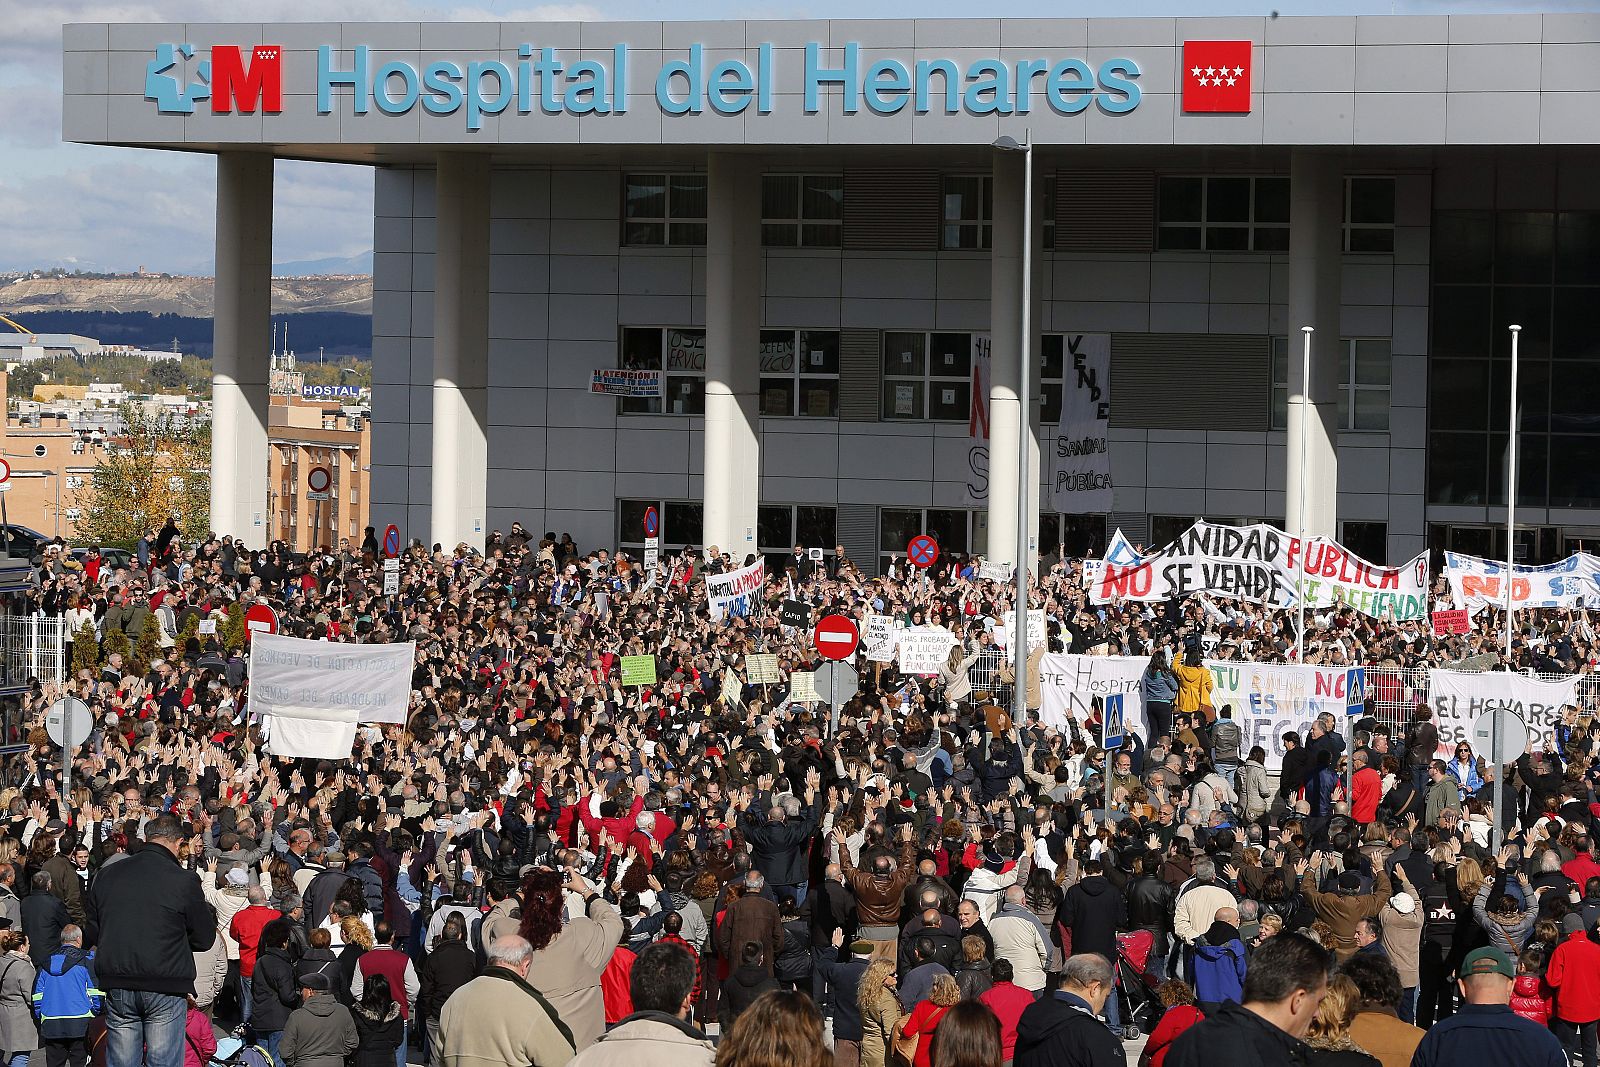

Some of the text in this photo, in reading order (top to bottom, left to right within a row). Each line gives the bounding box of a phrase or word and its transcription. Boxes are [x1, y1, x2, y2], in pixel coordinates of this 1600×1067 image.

[211, 45, 282, 113] M
[317, 42, 1142, 130] Hospital del Henares
[603, 370, 651, 380] ATENCIÓN
[303, 386, 358, 396] HOSTAL
[1163, 527, 1280, 563] ANIDAD
[708, 581, 734, 599] HOSPITAL
[732, 578, 743, 595] LA
[1101, 561, 1283, 606] NO SE VENDE
[917, 644, 947, 653] LUCHAR
[1076, 657, 1142, 692] HOSPITA
[1210, 664, 1240, 692] TU
[1250, 692, 1325, 718] ES UN
